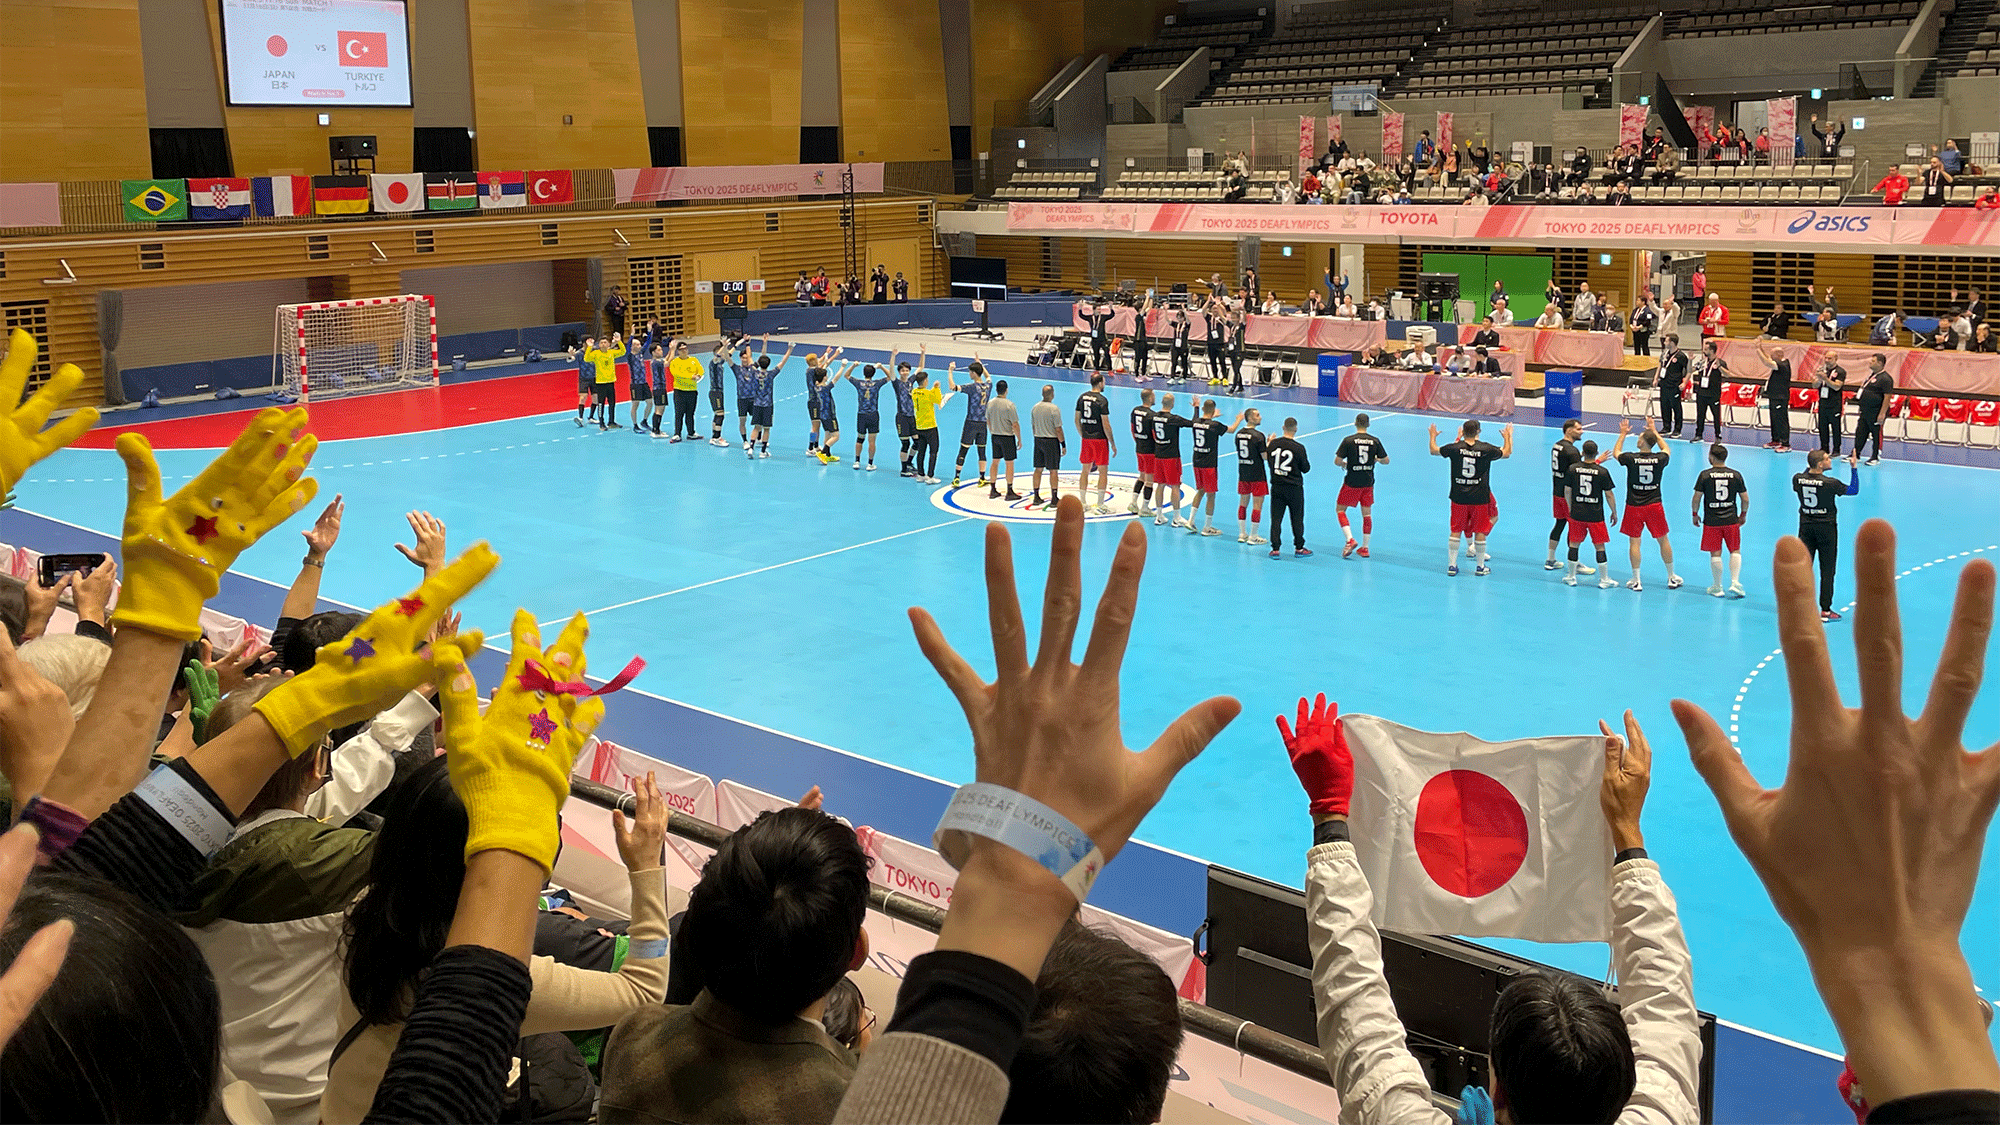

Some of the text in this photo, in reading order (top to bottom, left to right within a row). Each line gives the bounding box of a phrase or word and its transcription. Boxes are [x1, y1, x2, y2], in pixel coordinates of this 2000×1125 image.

[263, 70, 296, 79] JAPAN
[271, 80, 289, 90] 日本
[355, 83, 376, 91] トルコ
[683, 182, 798, 195] TOKYO 2025 DEAFLYMPICS
[1040, 205, 1083, 214] TOKYO 2025
[1045, 214, 1095, 223] DEAFLYMPICS
[1201, 218, 1233, 228] TOKYO
[1235, 218, 1258, 229] 2025
[1260, 219, 1330, 230] DEAFLYMPICS
[1379, 212, 1439, 225] TOYOTA
[1544, 222, 1721, 235] TOKYO 2025 DEAFLYMPICS
[723, 282, 743, 292] 0:00
[723, 294, 744, 304] 0 0
[1083, 401, 1092, 418] 5
[1135, 416, 1143, 433] 5
[1155, 422, 1165, 440] 5
[1195, 429, 1205, 447] 5
[1239, 440, 1249, 458] 5
[1358, 445, 1369, 464] 5
[1271, 447, 1293, 472] 12
[1462, 456, 1476, 478] 5
[1639, 464, 1654, 484] 5
[1579, 474, 1593, 496] 5
[1715, 479, 1729, 501] 5
[1802, 486, 1818, 508] 5
[665, 792, 695, 815] 2025
[884, 863, 940, 899] TOKYO
